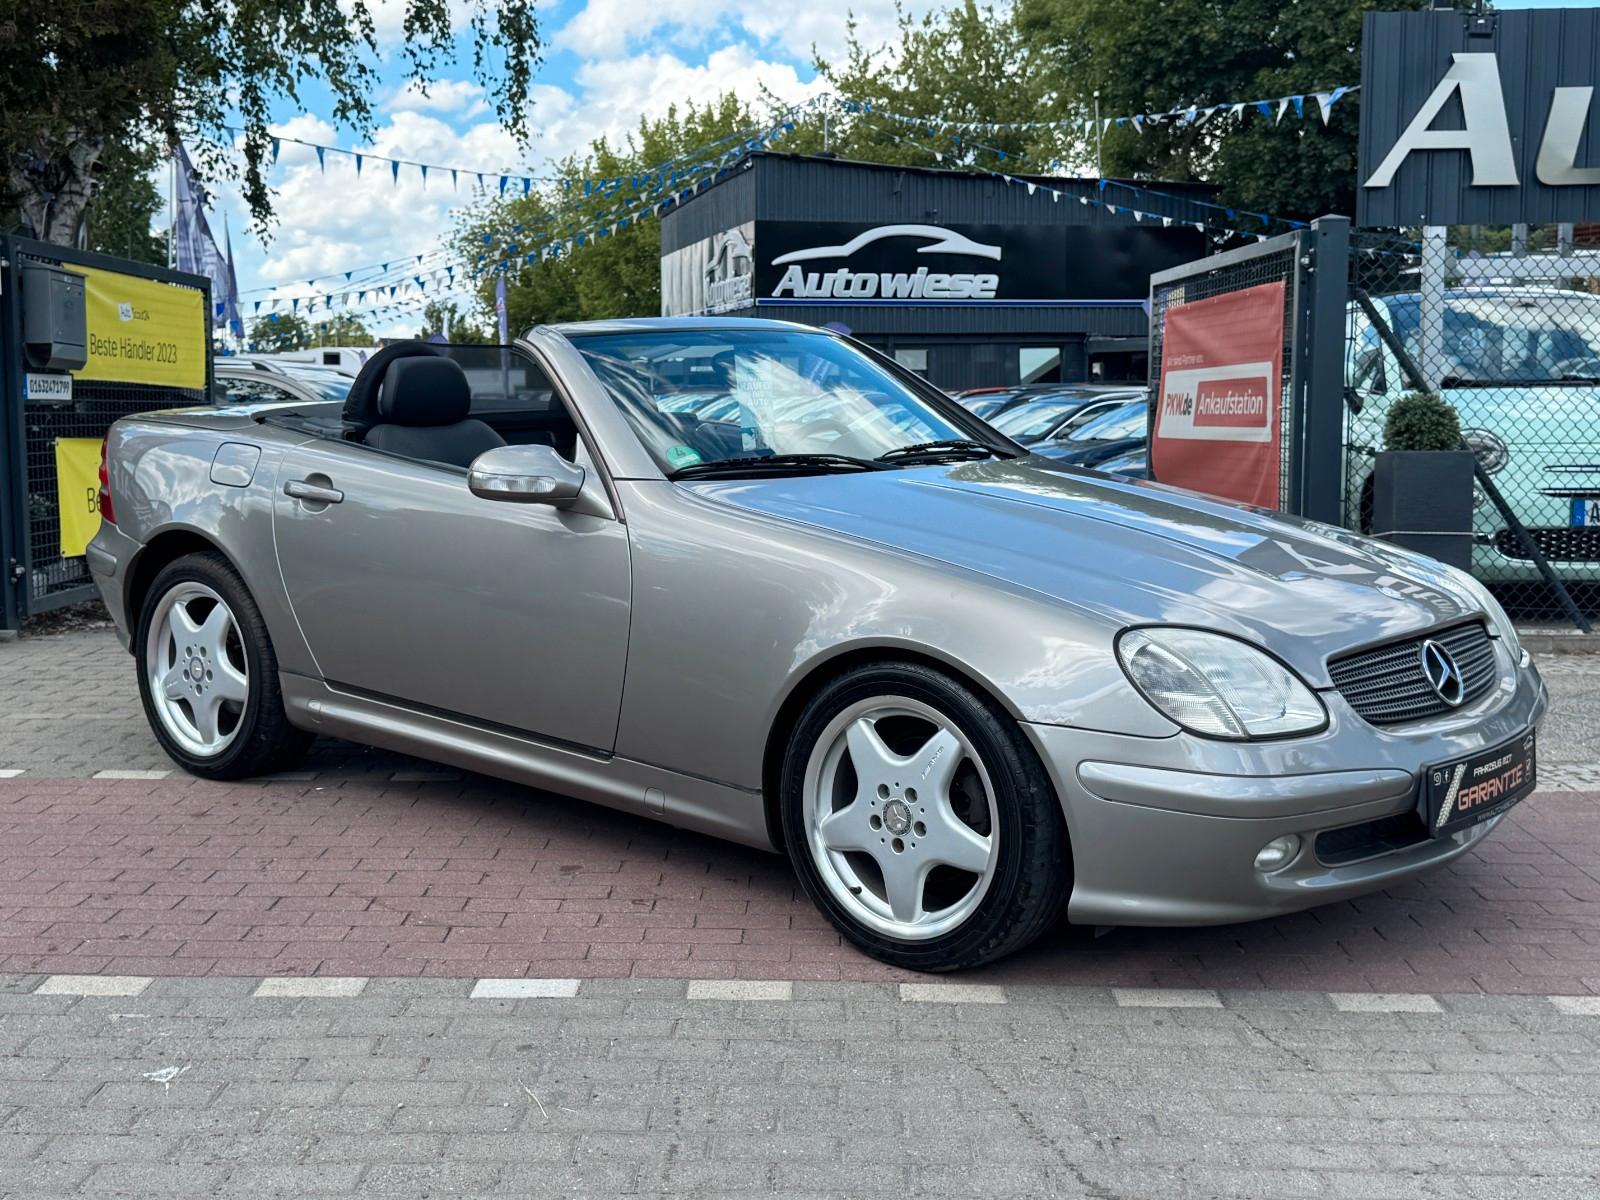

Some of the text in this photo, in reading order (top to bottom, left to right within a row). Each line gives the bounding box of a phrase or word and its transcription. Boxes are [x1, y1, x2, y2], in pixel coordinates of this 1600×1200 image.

[772, 264, 999, 299] Autowiese
[90, 332, 177, 364] Beste Händler 2023
[1197, 388, 1264, 416] Ankaufstation
[1458, 763, 1523, 811] GARANTIE
